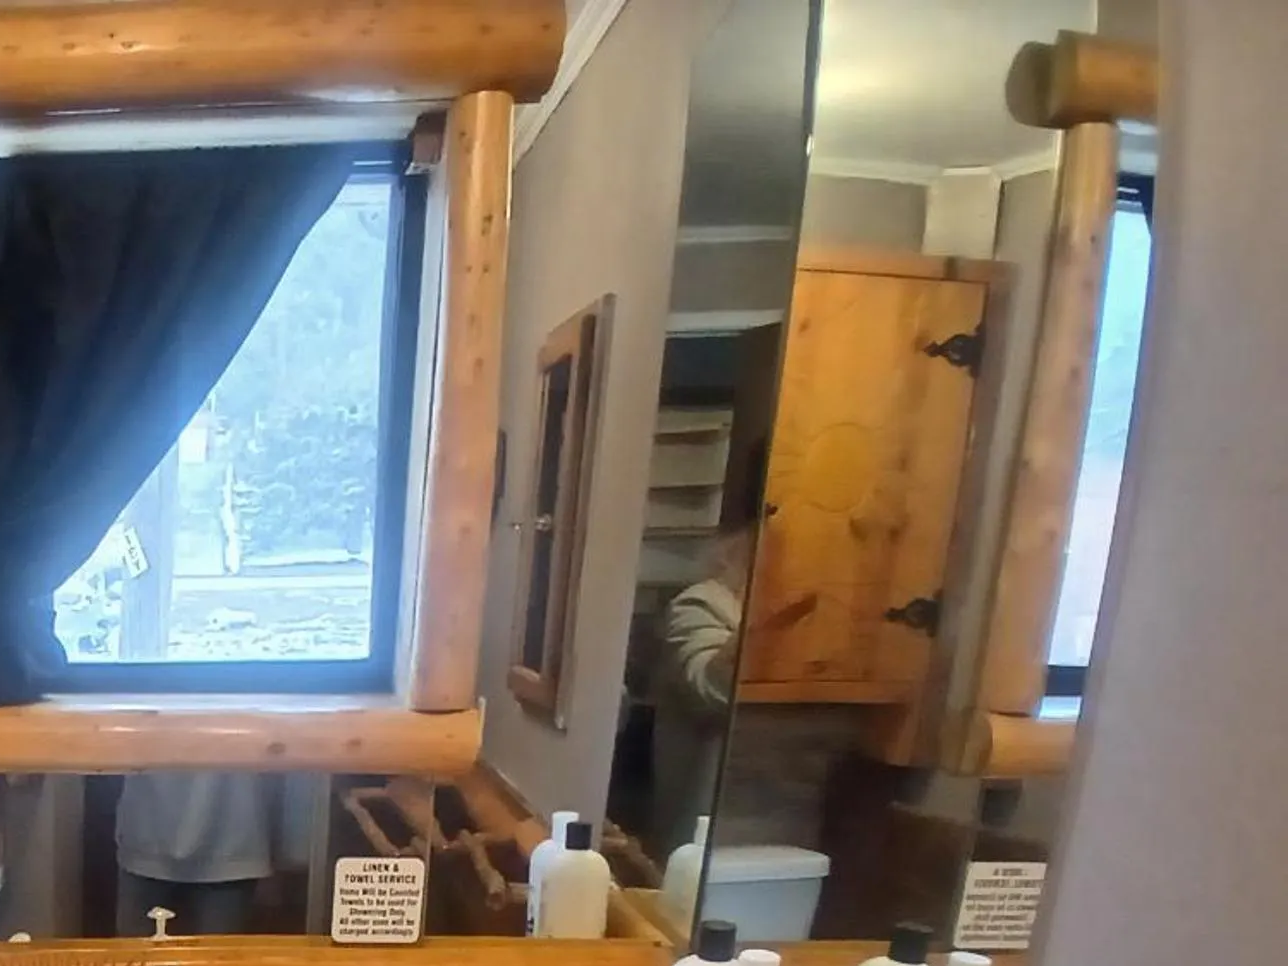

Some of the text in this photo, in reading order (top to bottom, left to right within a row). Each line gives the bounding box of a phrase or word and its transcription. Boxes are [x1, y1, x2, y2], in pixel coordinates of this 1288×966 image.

[362, 863, 399, 872] LINEN &
[344, 874, 416, 884] TOWEL SERVICE
